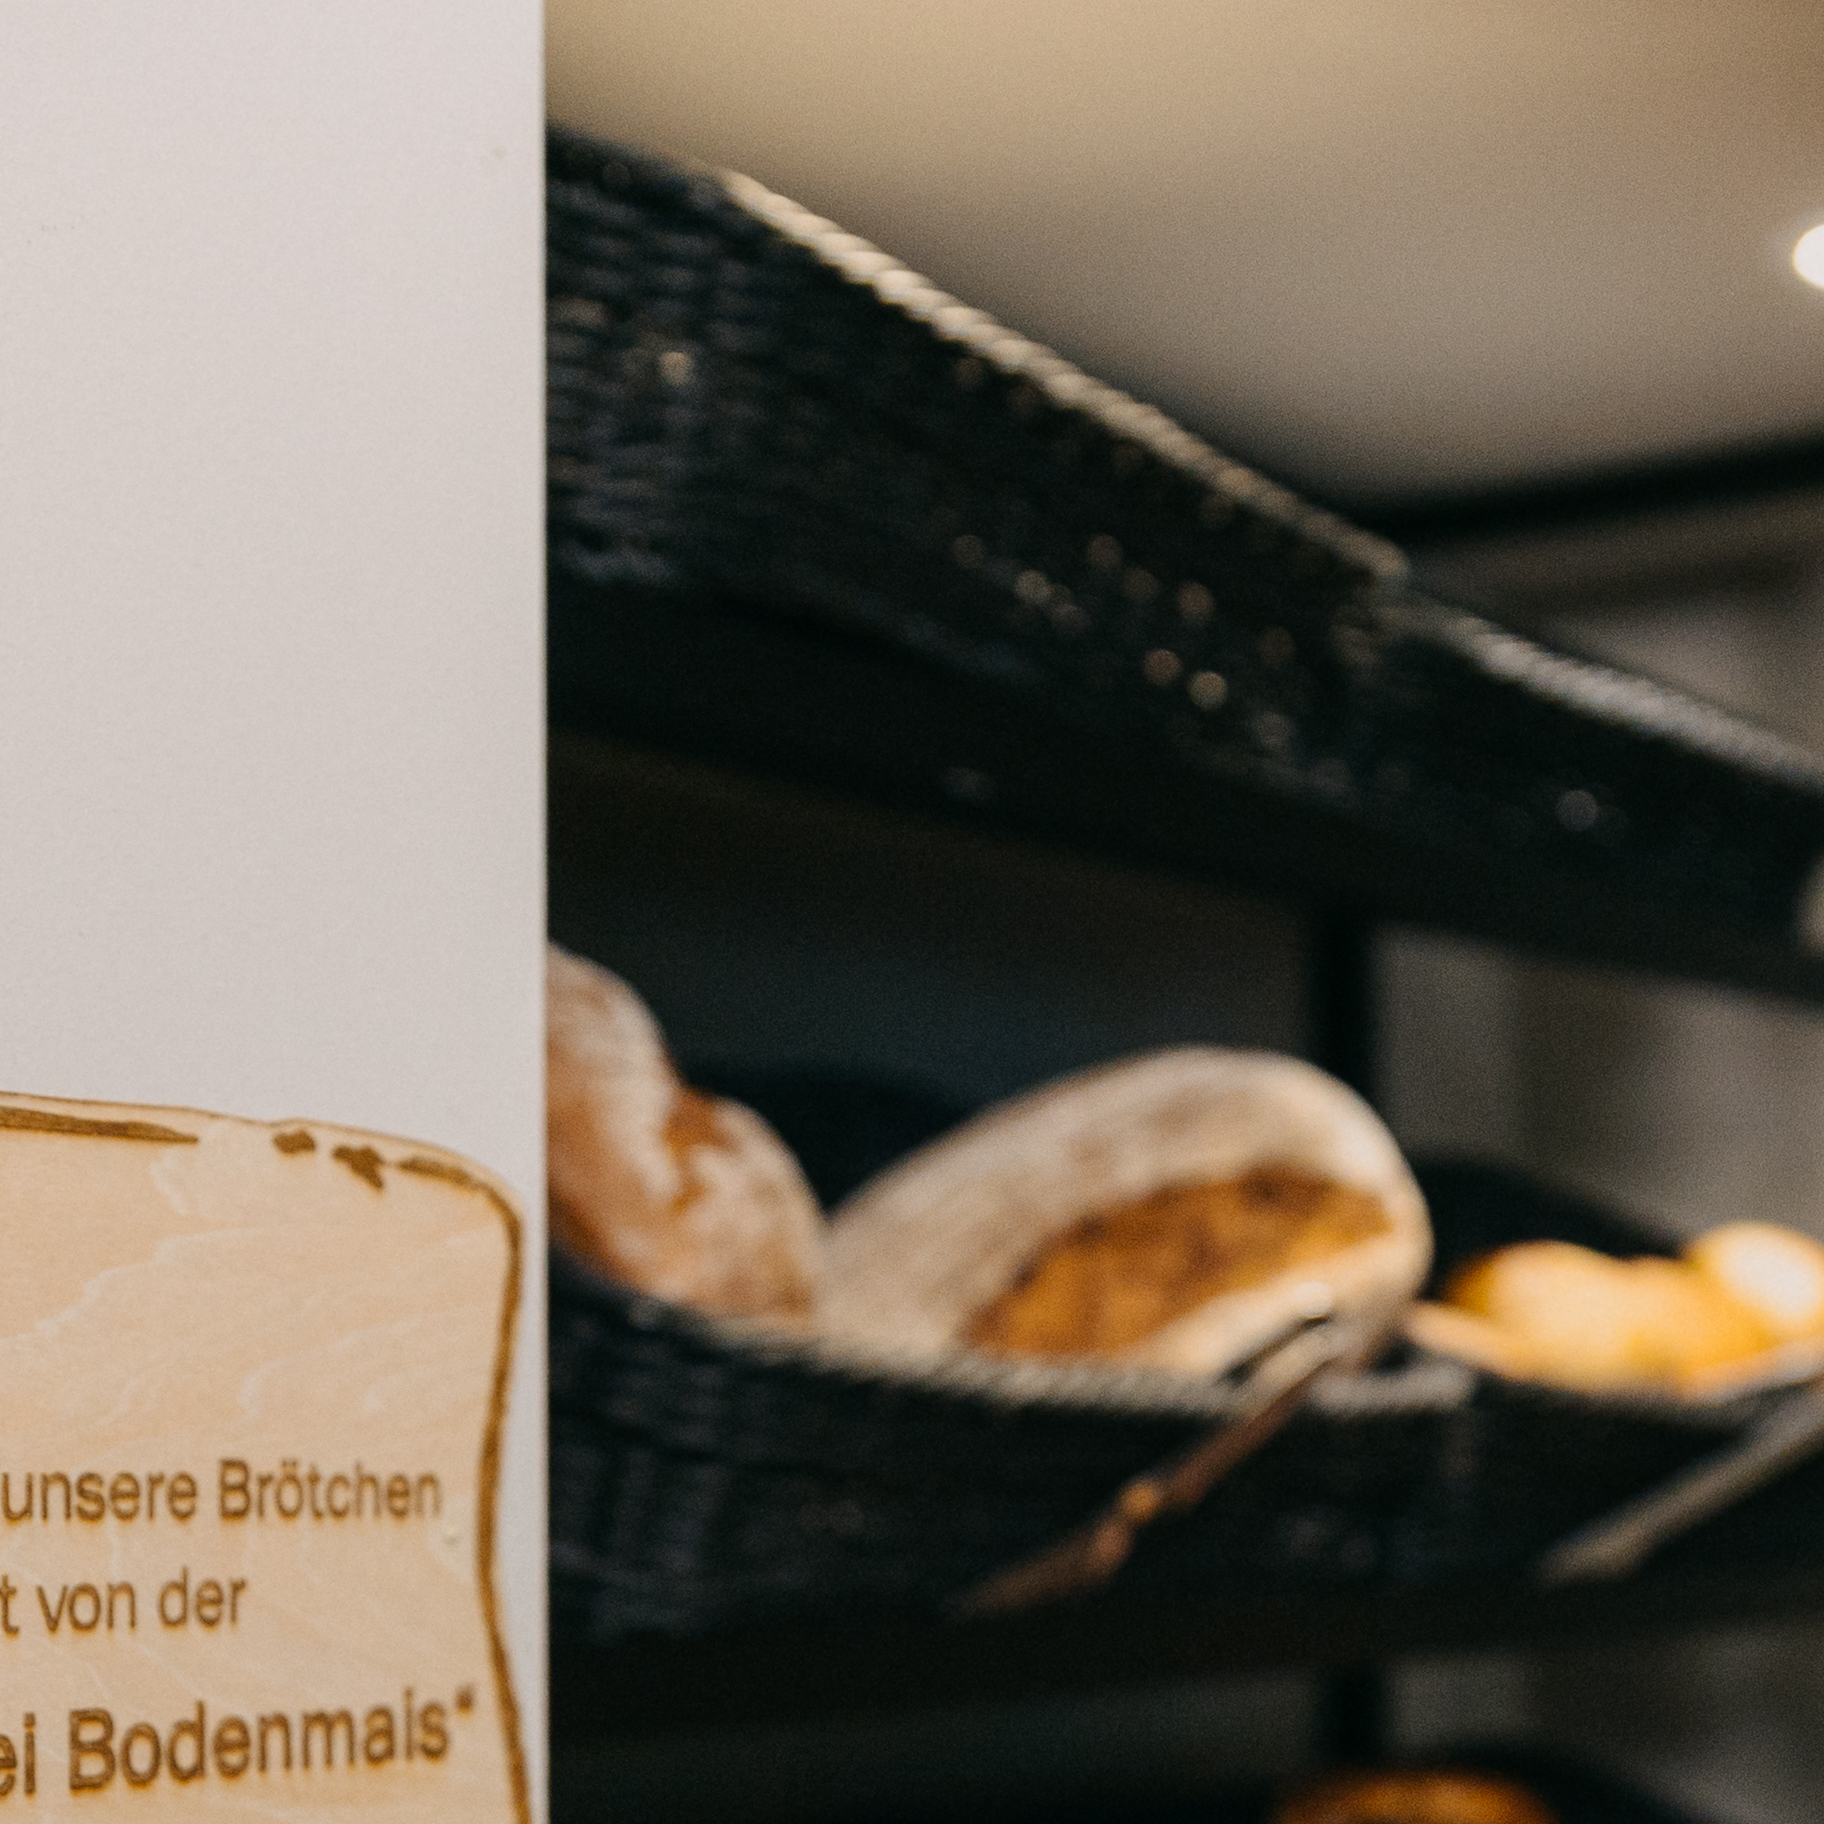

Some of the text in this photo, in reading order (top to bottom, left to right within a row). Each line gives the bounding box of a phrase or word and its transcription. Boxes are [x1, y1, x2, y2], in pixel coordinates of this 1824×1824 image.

[0, 1463, 199, 1522] unsere
[217, 1458, 443, 1520] Brötchen
[36, 1578, 137, 1632] von
[157, 1566, 246, 1629] der
